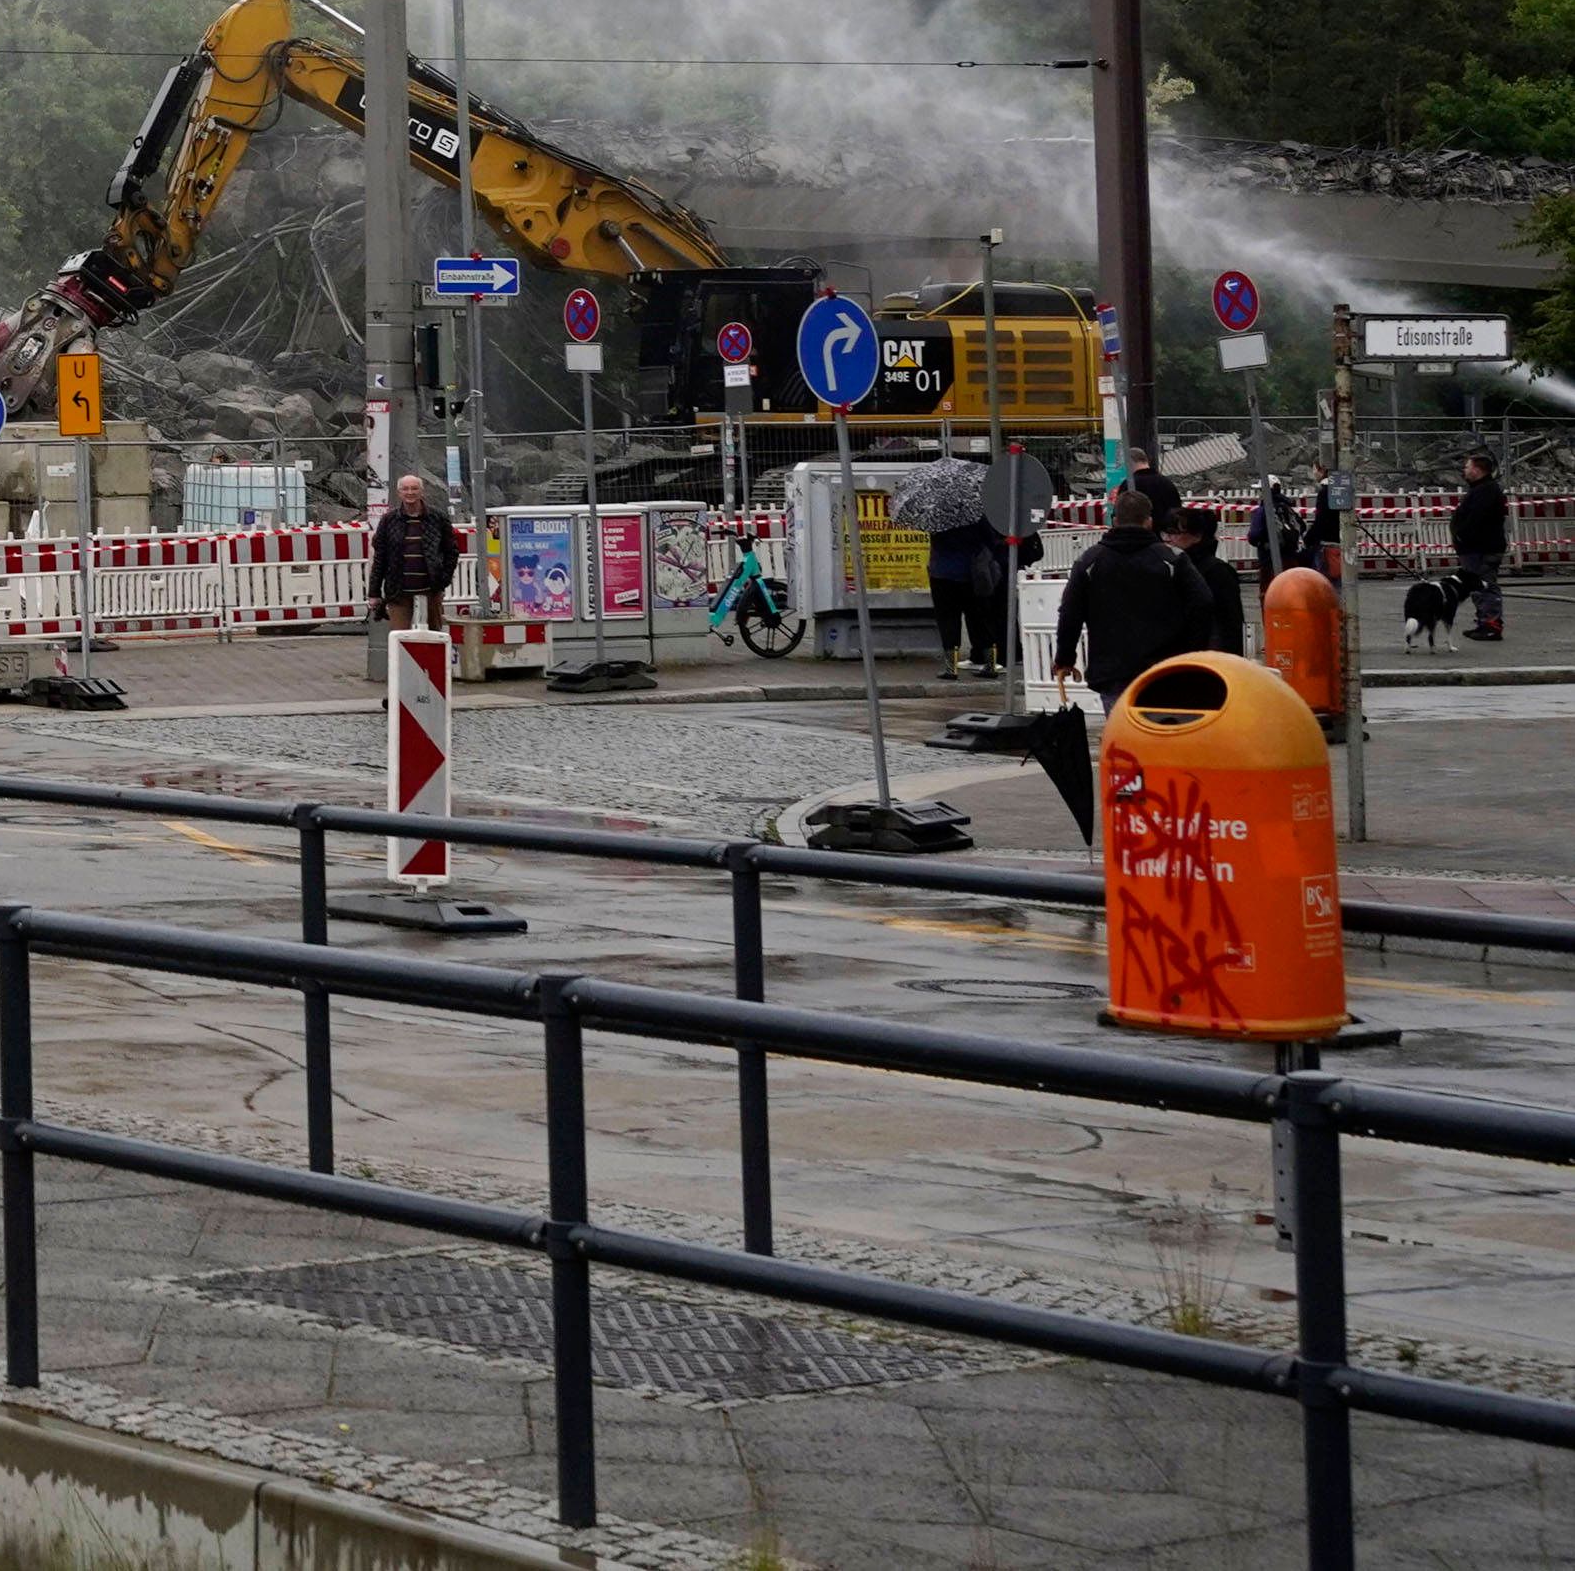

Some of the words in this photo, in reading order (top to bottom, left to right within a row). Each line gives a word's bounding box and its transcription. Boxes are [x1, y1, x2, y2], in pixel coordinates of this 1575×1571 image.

[440, 272, 495, 281] Einbahnstraße
[1396, 326, 1473, 346] Edisonstraße
[883, 340, 926, 368] CAT
[74, 360, 85, 378] U
[884, 371, 911, 382] 349E
[915, 369, 941, 392] 01
